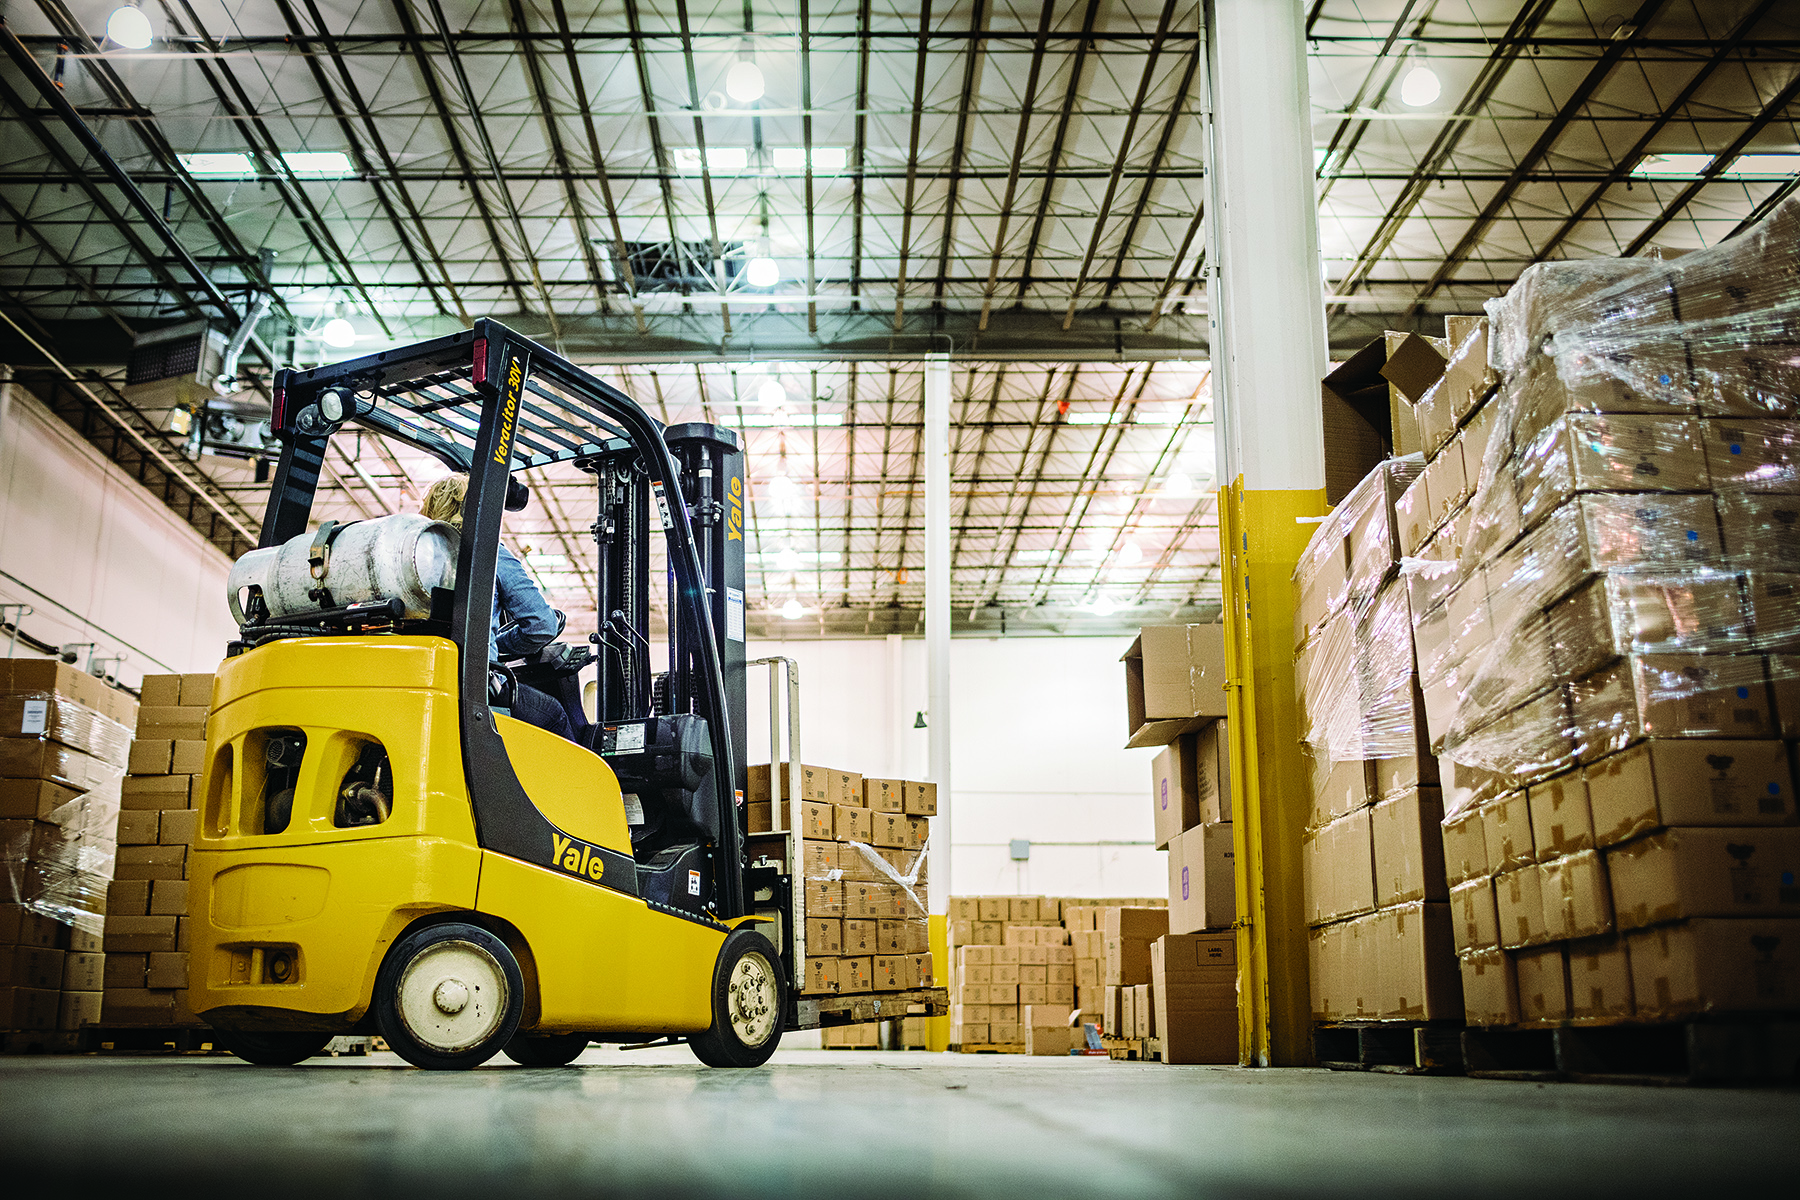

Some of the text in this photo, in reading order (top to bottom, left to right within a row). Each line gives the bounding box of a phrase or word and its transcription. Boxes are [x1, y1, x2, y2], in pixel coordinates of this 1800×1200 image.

[493, 390, 517, 465] Veracitor
[727, 476, 742, 541] Yale
[552, 832, 605, 880] Yale
